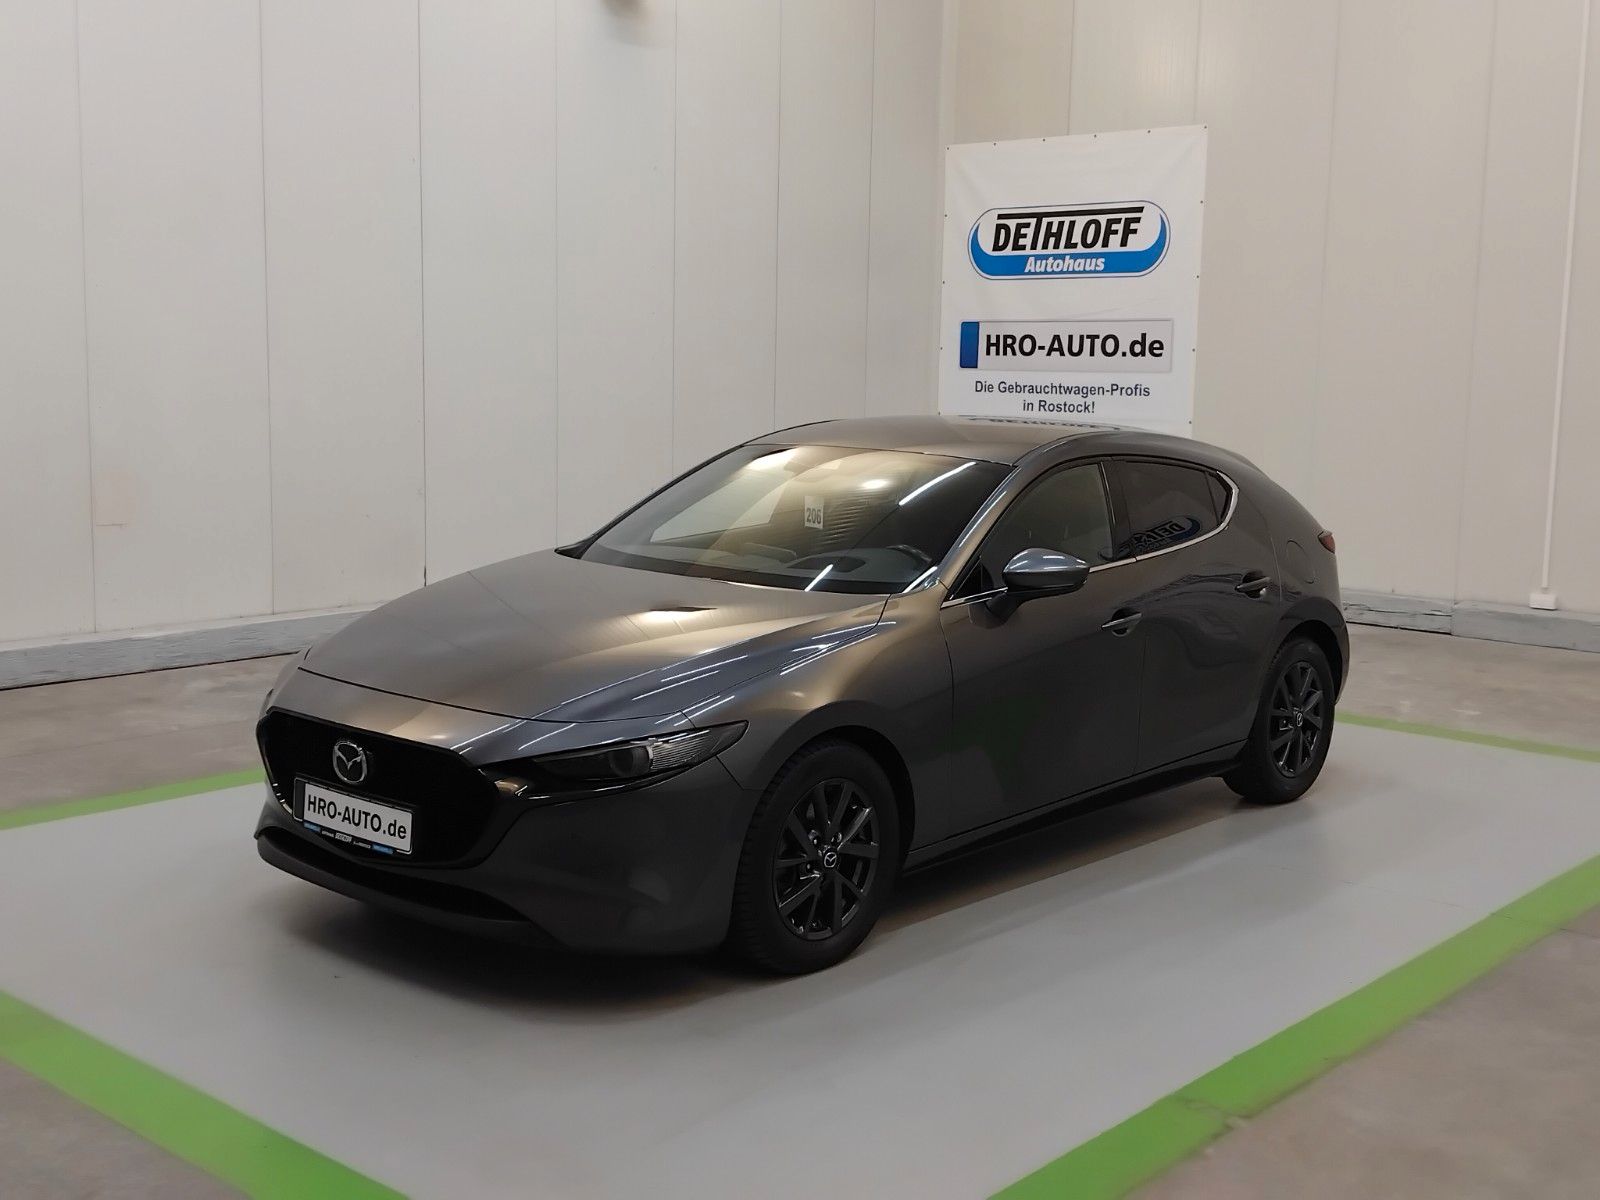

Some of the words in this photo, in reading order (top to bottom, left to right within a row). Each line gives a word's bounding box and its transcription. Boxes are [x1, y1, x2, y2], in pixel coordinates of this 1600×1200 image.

[992, 206, 1145, 253] DETHLOFF
[1024, 255, 1105, 273] Autohaus
[985, 333, 1164, 358] HRO-AUTO.de
[974, 381, 994, 394] Die
[997, 381, 1151, 398] Gebrauchtwagen-Profis
[1023, 400, 1034, 412] in
[1038, 400, 1095, 414] Rostock!
[806, 507, 822, 525] 206
[307, 794, 407, 839] HRO-AUTO.de
